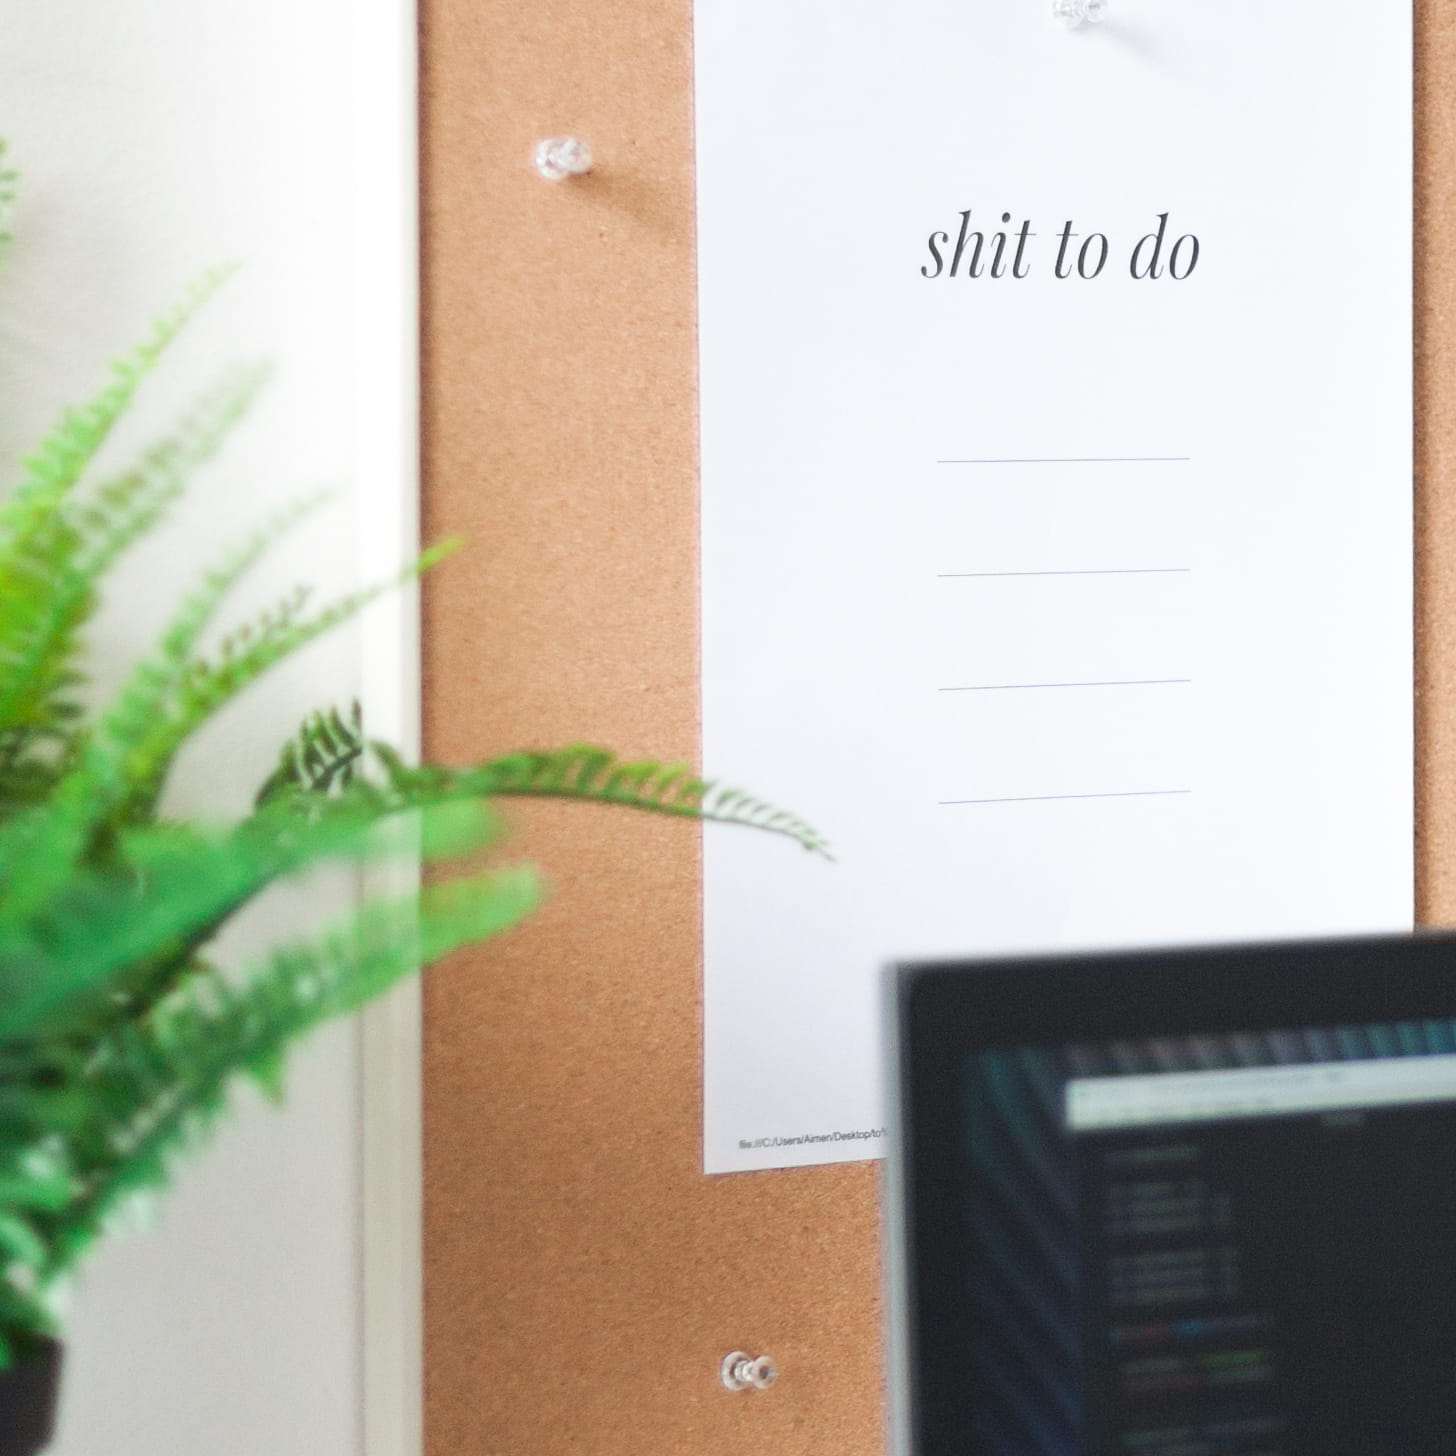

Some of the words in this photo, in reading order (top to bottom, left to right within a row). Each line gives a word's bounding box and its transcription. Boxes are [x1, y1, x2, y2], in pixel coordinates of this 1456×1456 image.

[920, 208, 1038, 280] shit
[1054, 219, 1109, 280] to
[1129, 211, 1201, 281] do
